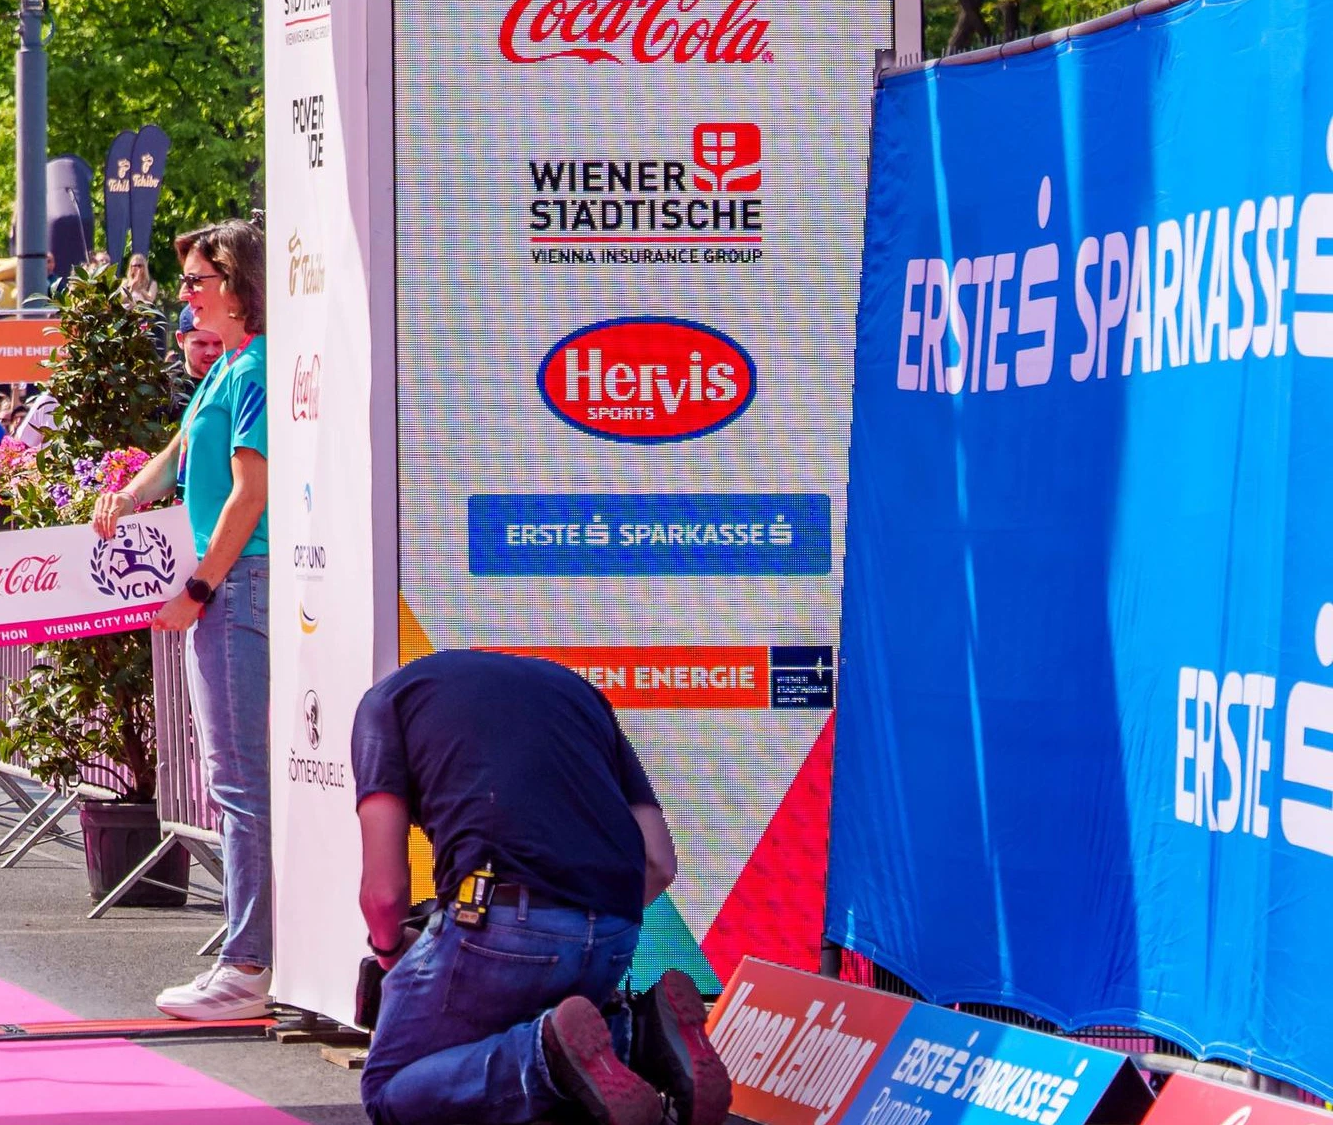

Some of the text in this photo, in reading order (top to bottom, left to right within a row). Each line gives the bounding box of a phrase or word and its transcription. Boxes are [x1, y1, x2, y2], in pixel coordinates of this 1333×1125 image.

[132, 175, 160, 188] Tchibo
[528, 160, 687, 193] WIENER
[530, 199, 763, 232] STÄDTISCHE
[531, 248, 764, 264] VIENNA INSURANCE GROUP
[896, 195, 1295, 395] ERSTE SPARKASSE
[564, 348, 738, 414] Hervis
[586, 406, 655, 421] SPORTS
[506, 523, 765, 546] ERSTE SPARKASSE
[117, 579, 163, 601] VCM
[44, 621, 92, 636] VIENNA
[94, 616, 121, 630] CITY
[635, 666, 756, 689] ENERGIE
[1174, 666, 1275, 840] ERSTE
[773, 1000, 877, 1125] Zeitung
[891, 1037, 1063, 1122] ERSTE SPARKASSE
